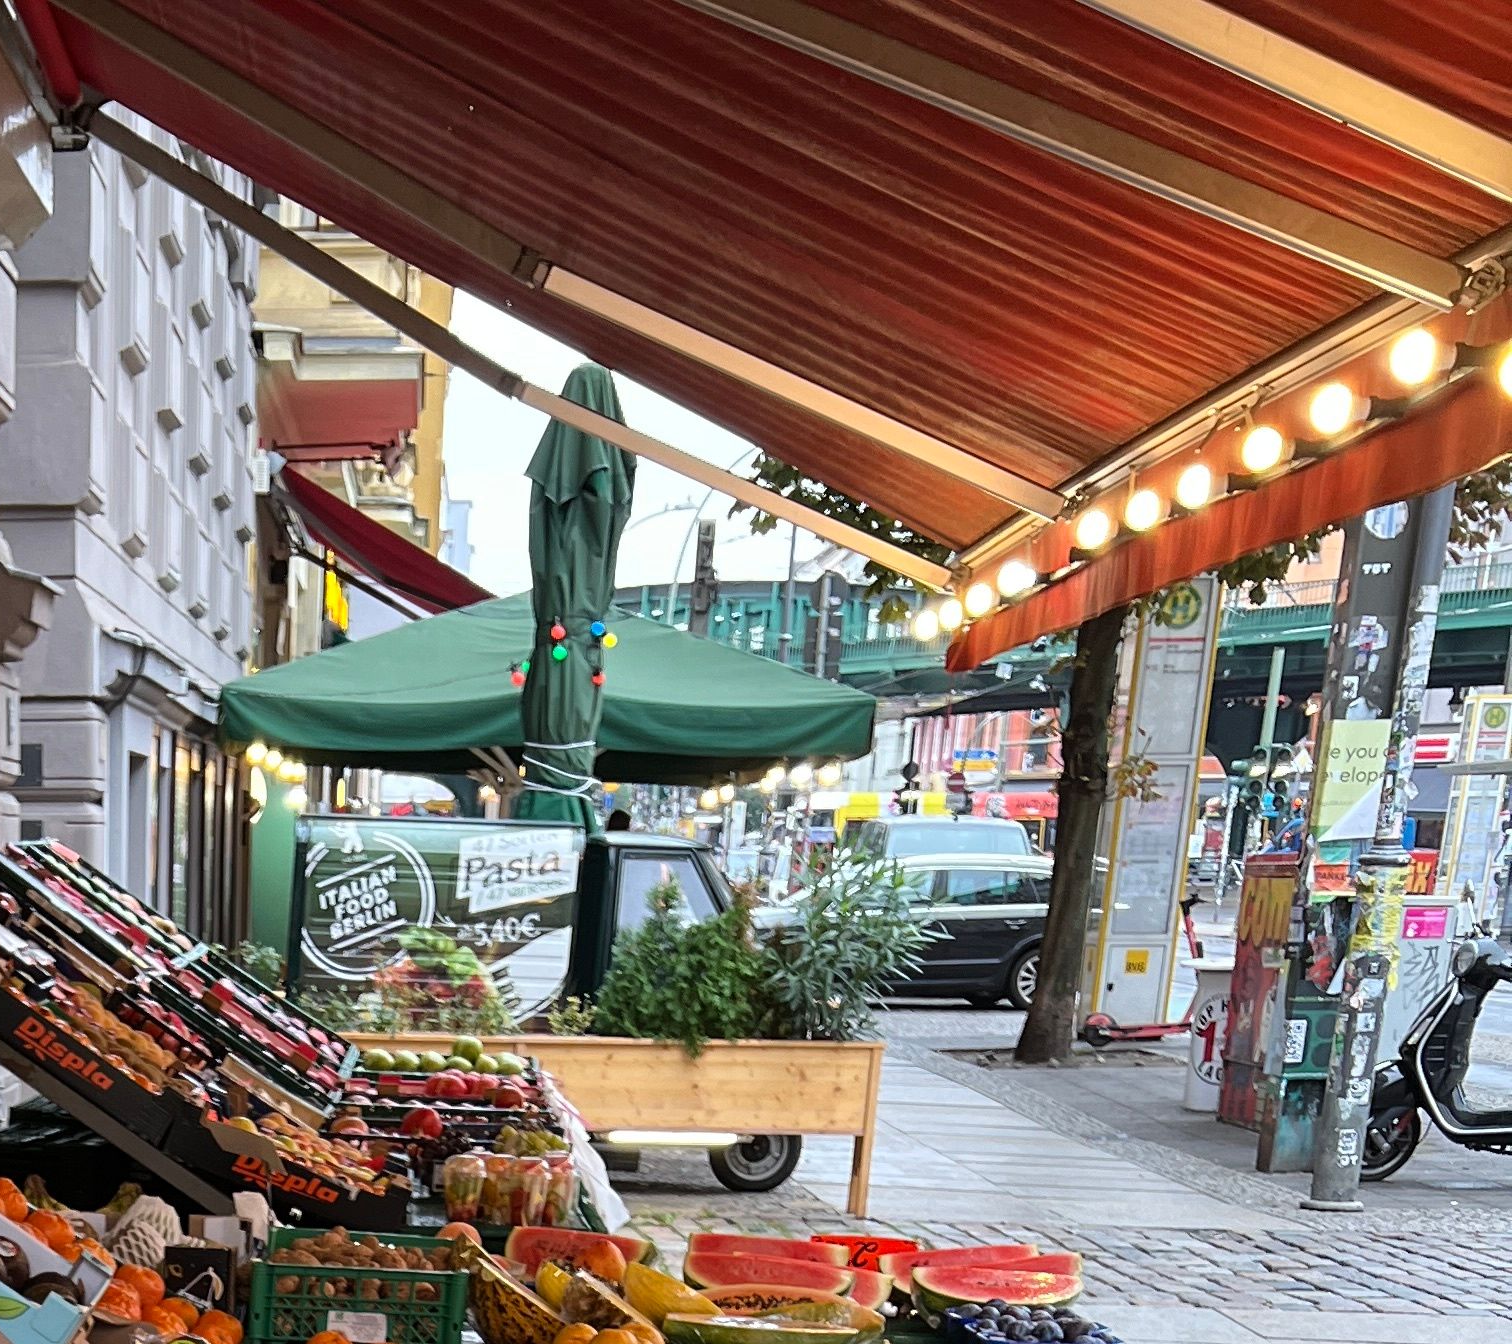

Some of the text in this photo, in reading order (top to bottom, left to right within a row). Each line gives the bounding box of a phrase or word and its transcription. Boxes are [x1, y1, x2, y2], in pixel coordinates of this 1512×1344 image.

[1345, 746, 1378, 762] you
[319, 865, 398, 910] ITALIAN
[462, 850, 560, 893] Pasta
[329, 900, 398, 940] BERLIN
[334, 887, 389, 920] FOOD
